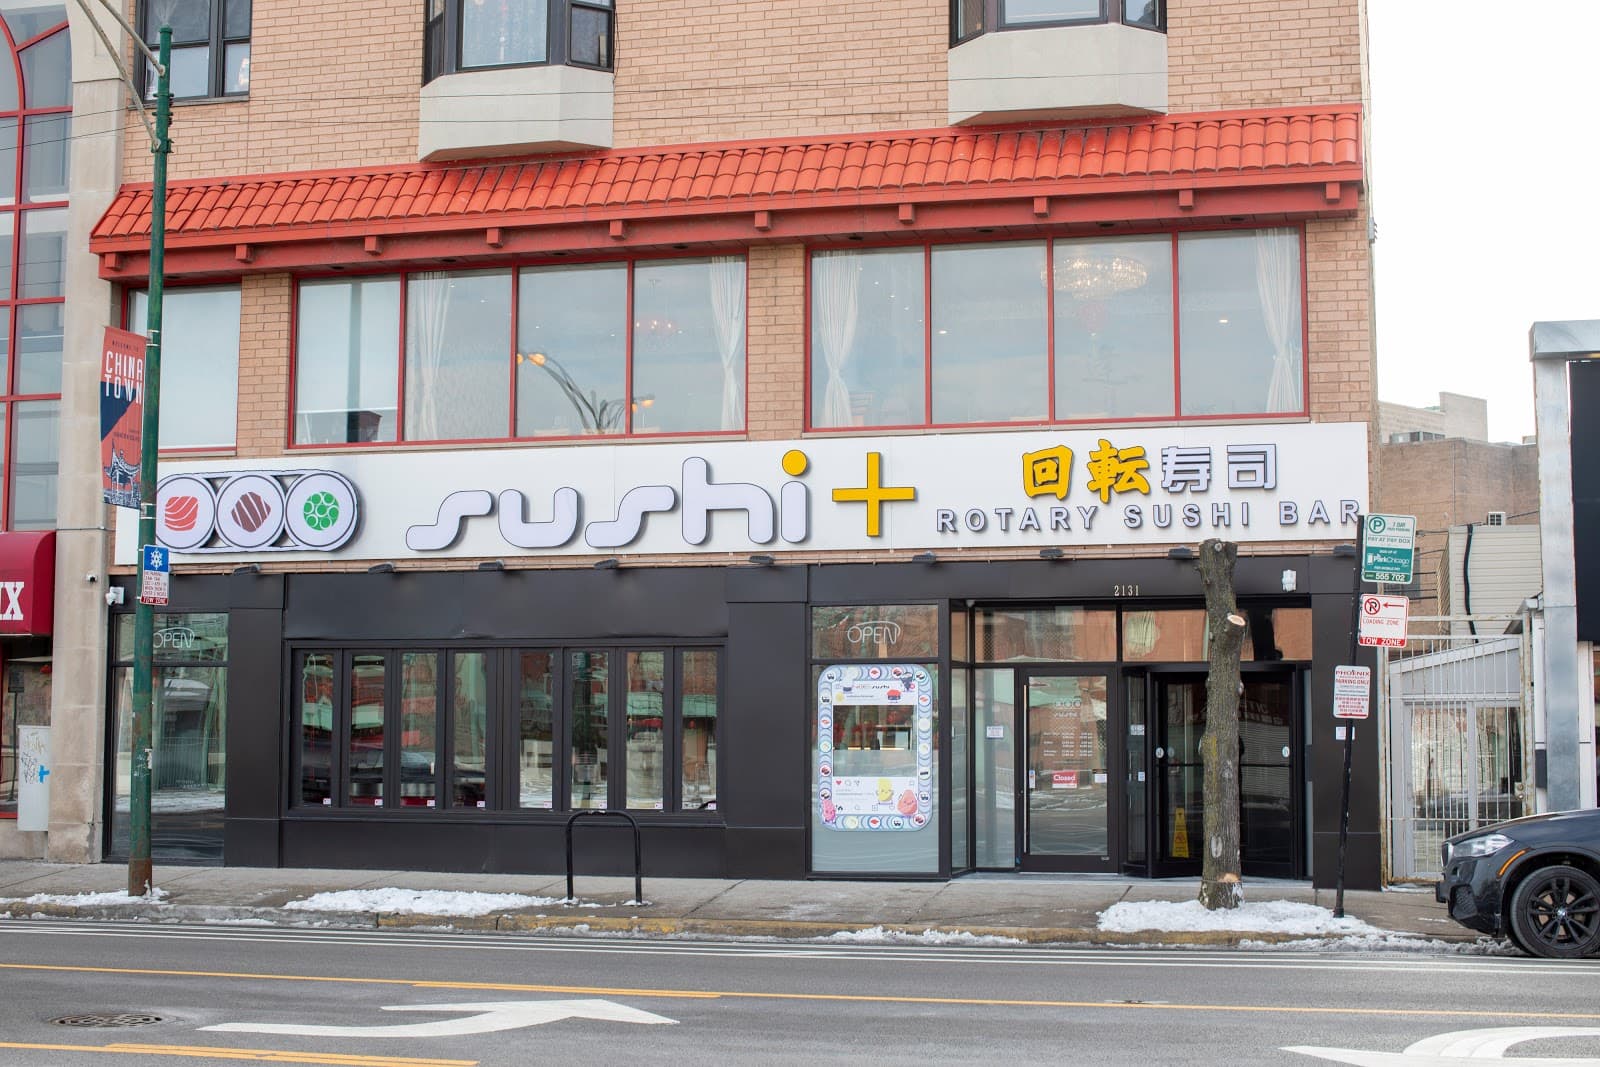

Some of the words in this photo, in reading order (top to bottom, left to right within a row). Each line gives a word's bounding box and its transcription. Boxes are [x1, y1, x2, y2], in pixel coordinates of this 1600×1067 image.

[105, 351, 143, 381] CHINA
[104, 373, 142, 404] TOWN
[1022, 439, 1277, 503] 回転寿司
[937, 505, 1098, 533] ROTARY
[1124, 501, 1250, 528] SUSHI
[1280, 500, 1360, 525] BAR
[1391, 573, 1405, 581] 702
[1114, 584, 1139, 597] 2131
[153, 632, 192, 648] OPEN
[847, 625, 898, 645] OPEN
[1362, 637, 1377, 645] TOW
[1381, 638, 1401, 647] ZONE
[1053, 774, 1076, 782] Closed
